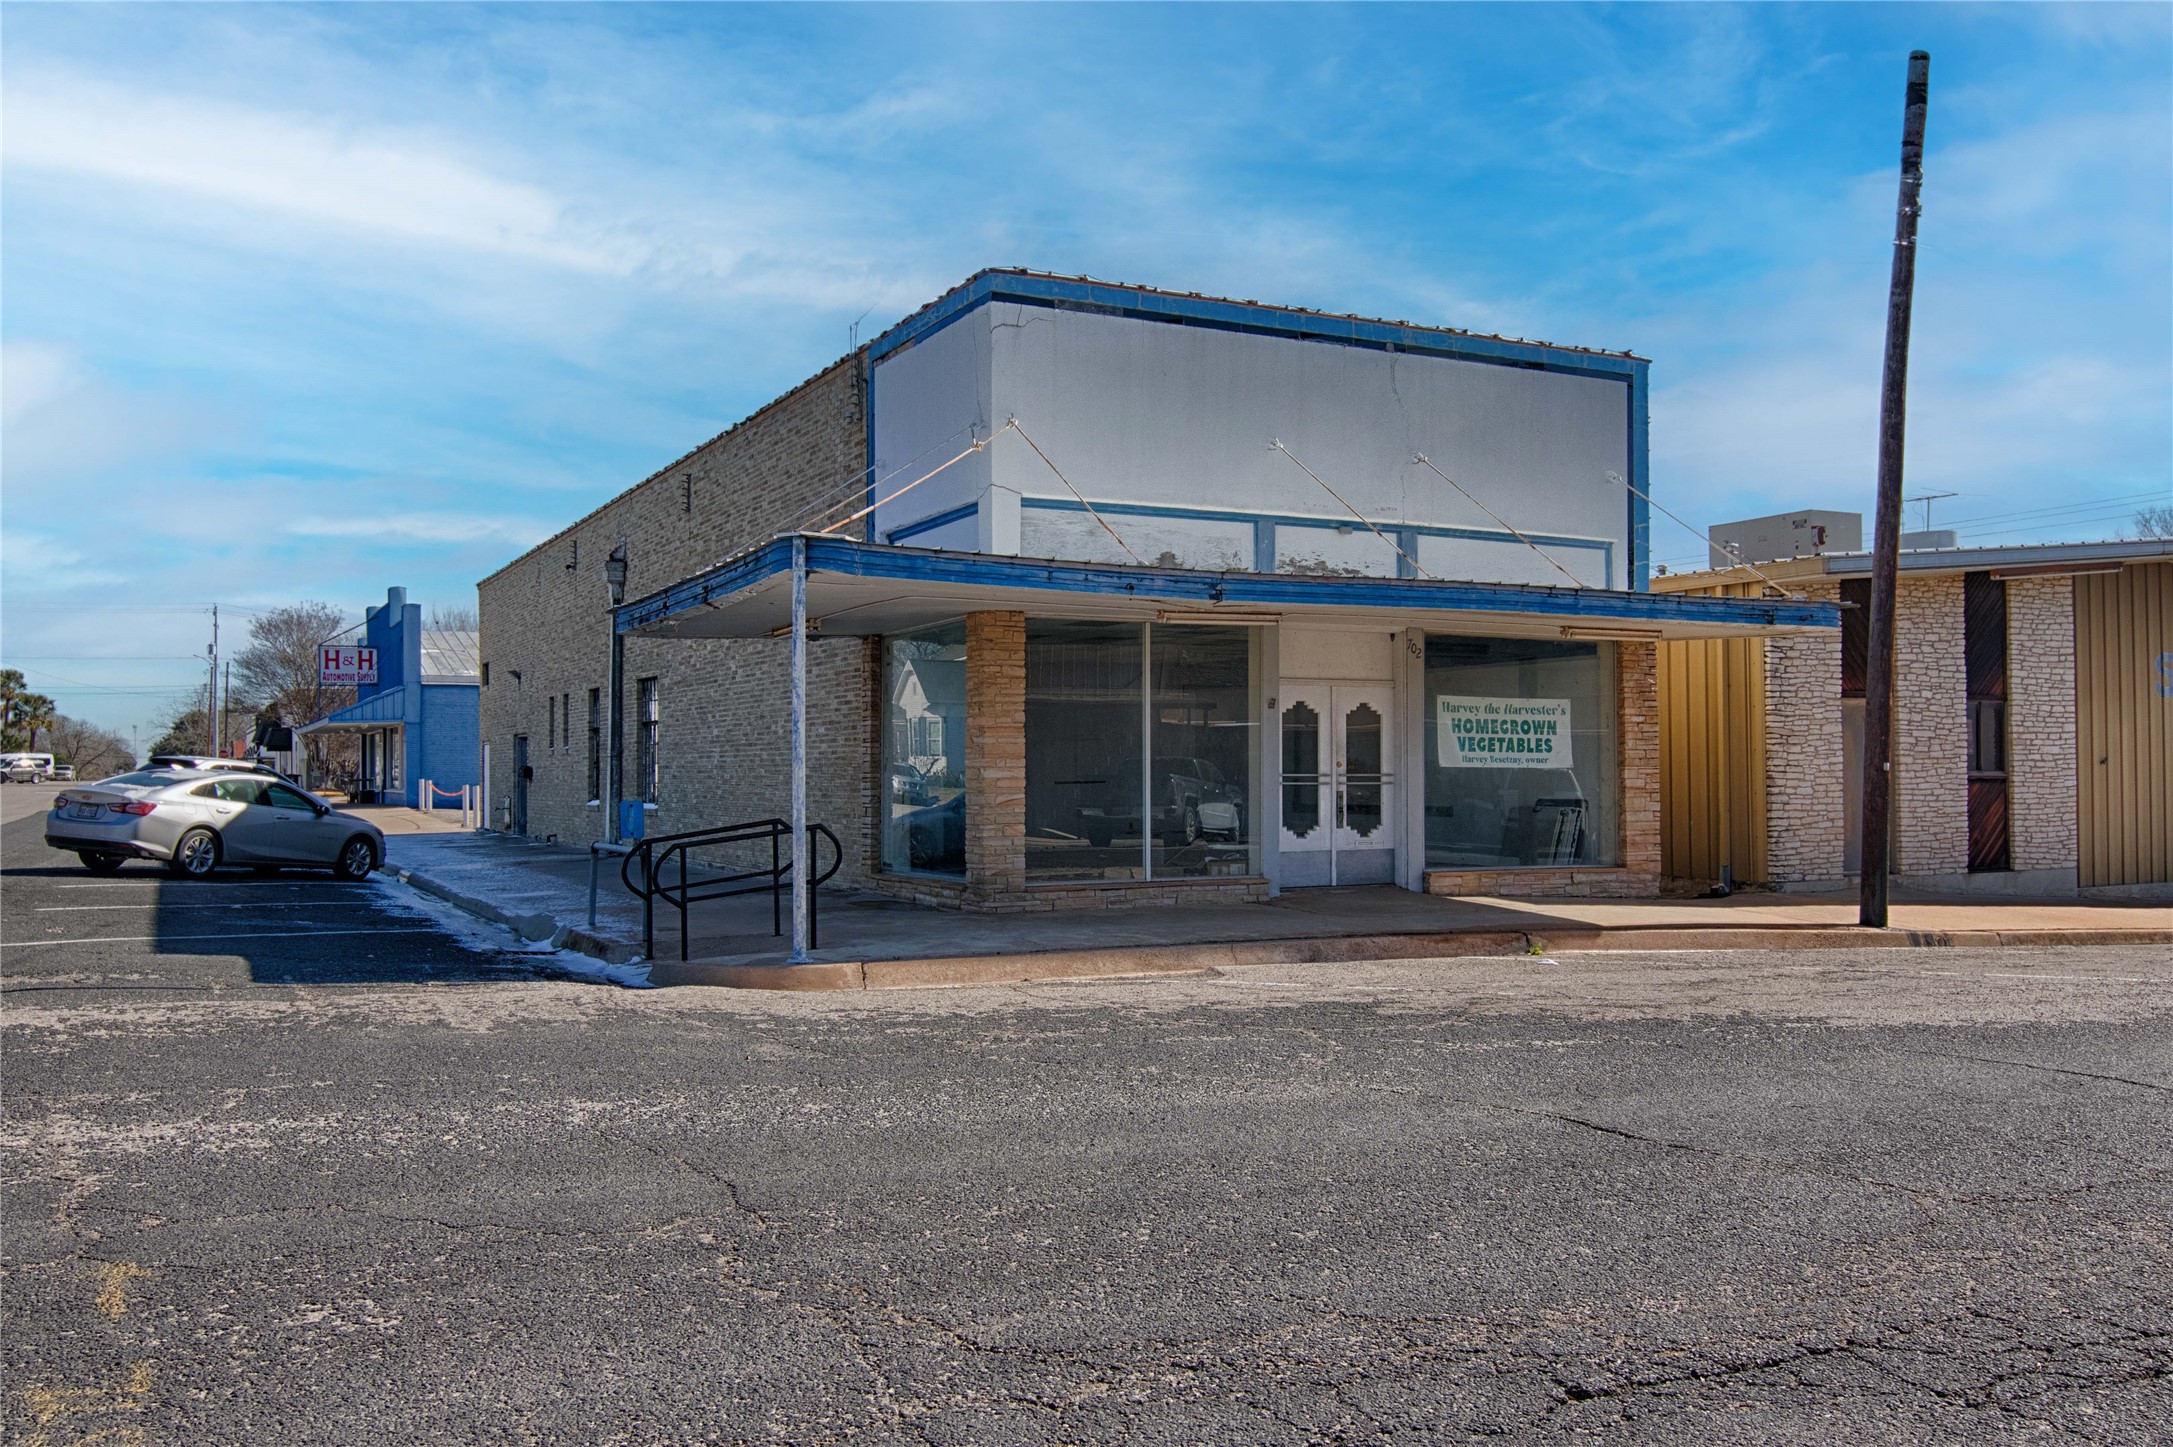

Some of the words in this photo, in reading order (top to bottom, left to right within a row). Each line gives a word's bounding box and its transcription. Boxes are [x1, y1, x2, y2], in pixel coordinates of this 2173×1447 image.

[1407, 638, 1422, 659] 702
[324, 649, 340, 670] H
[342, 656, 355, 666] &
[357, 650, 374, 671] H
[322, 671, 355, 682] AUTOMOTIVE
[357, 671, 376, 682] SUPPLY
[1441, 701, 1481, 716] Harvey
[1484, 702, 1501, 714] the
[1503, 703, 1567, 716] Harvester's
[1450, 717, 1558, 736] HOMEGROWN
[1456, 736, 1553, 754] VEGETABLES
[1461, 755, 1488, 765] Harvey
[1525, 757, 1550, 765] owner
